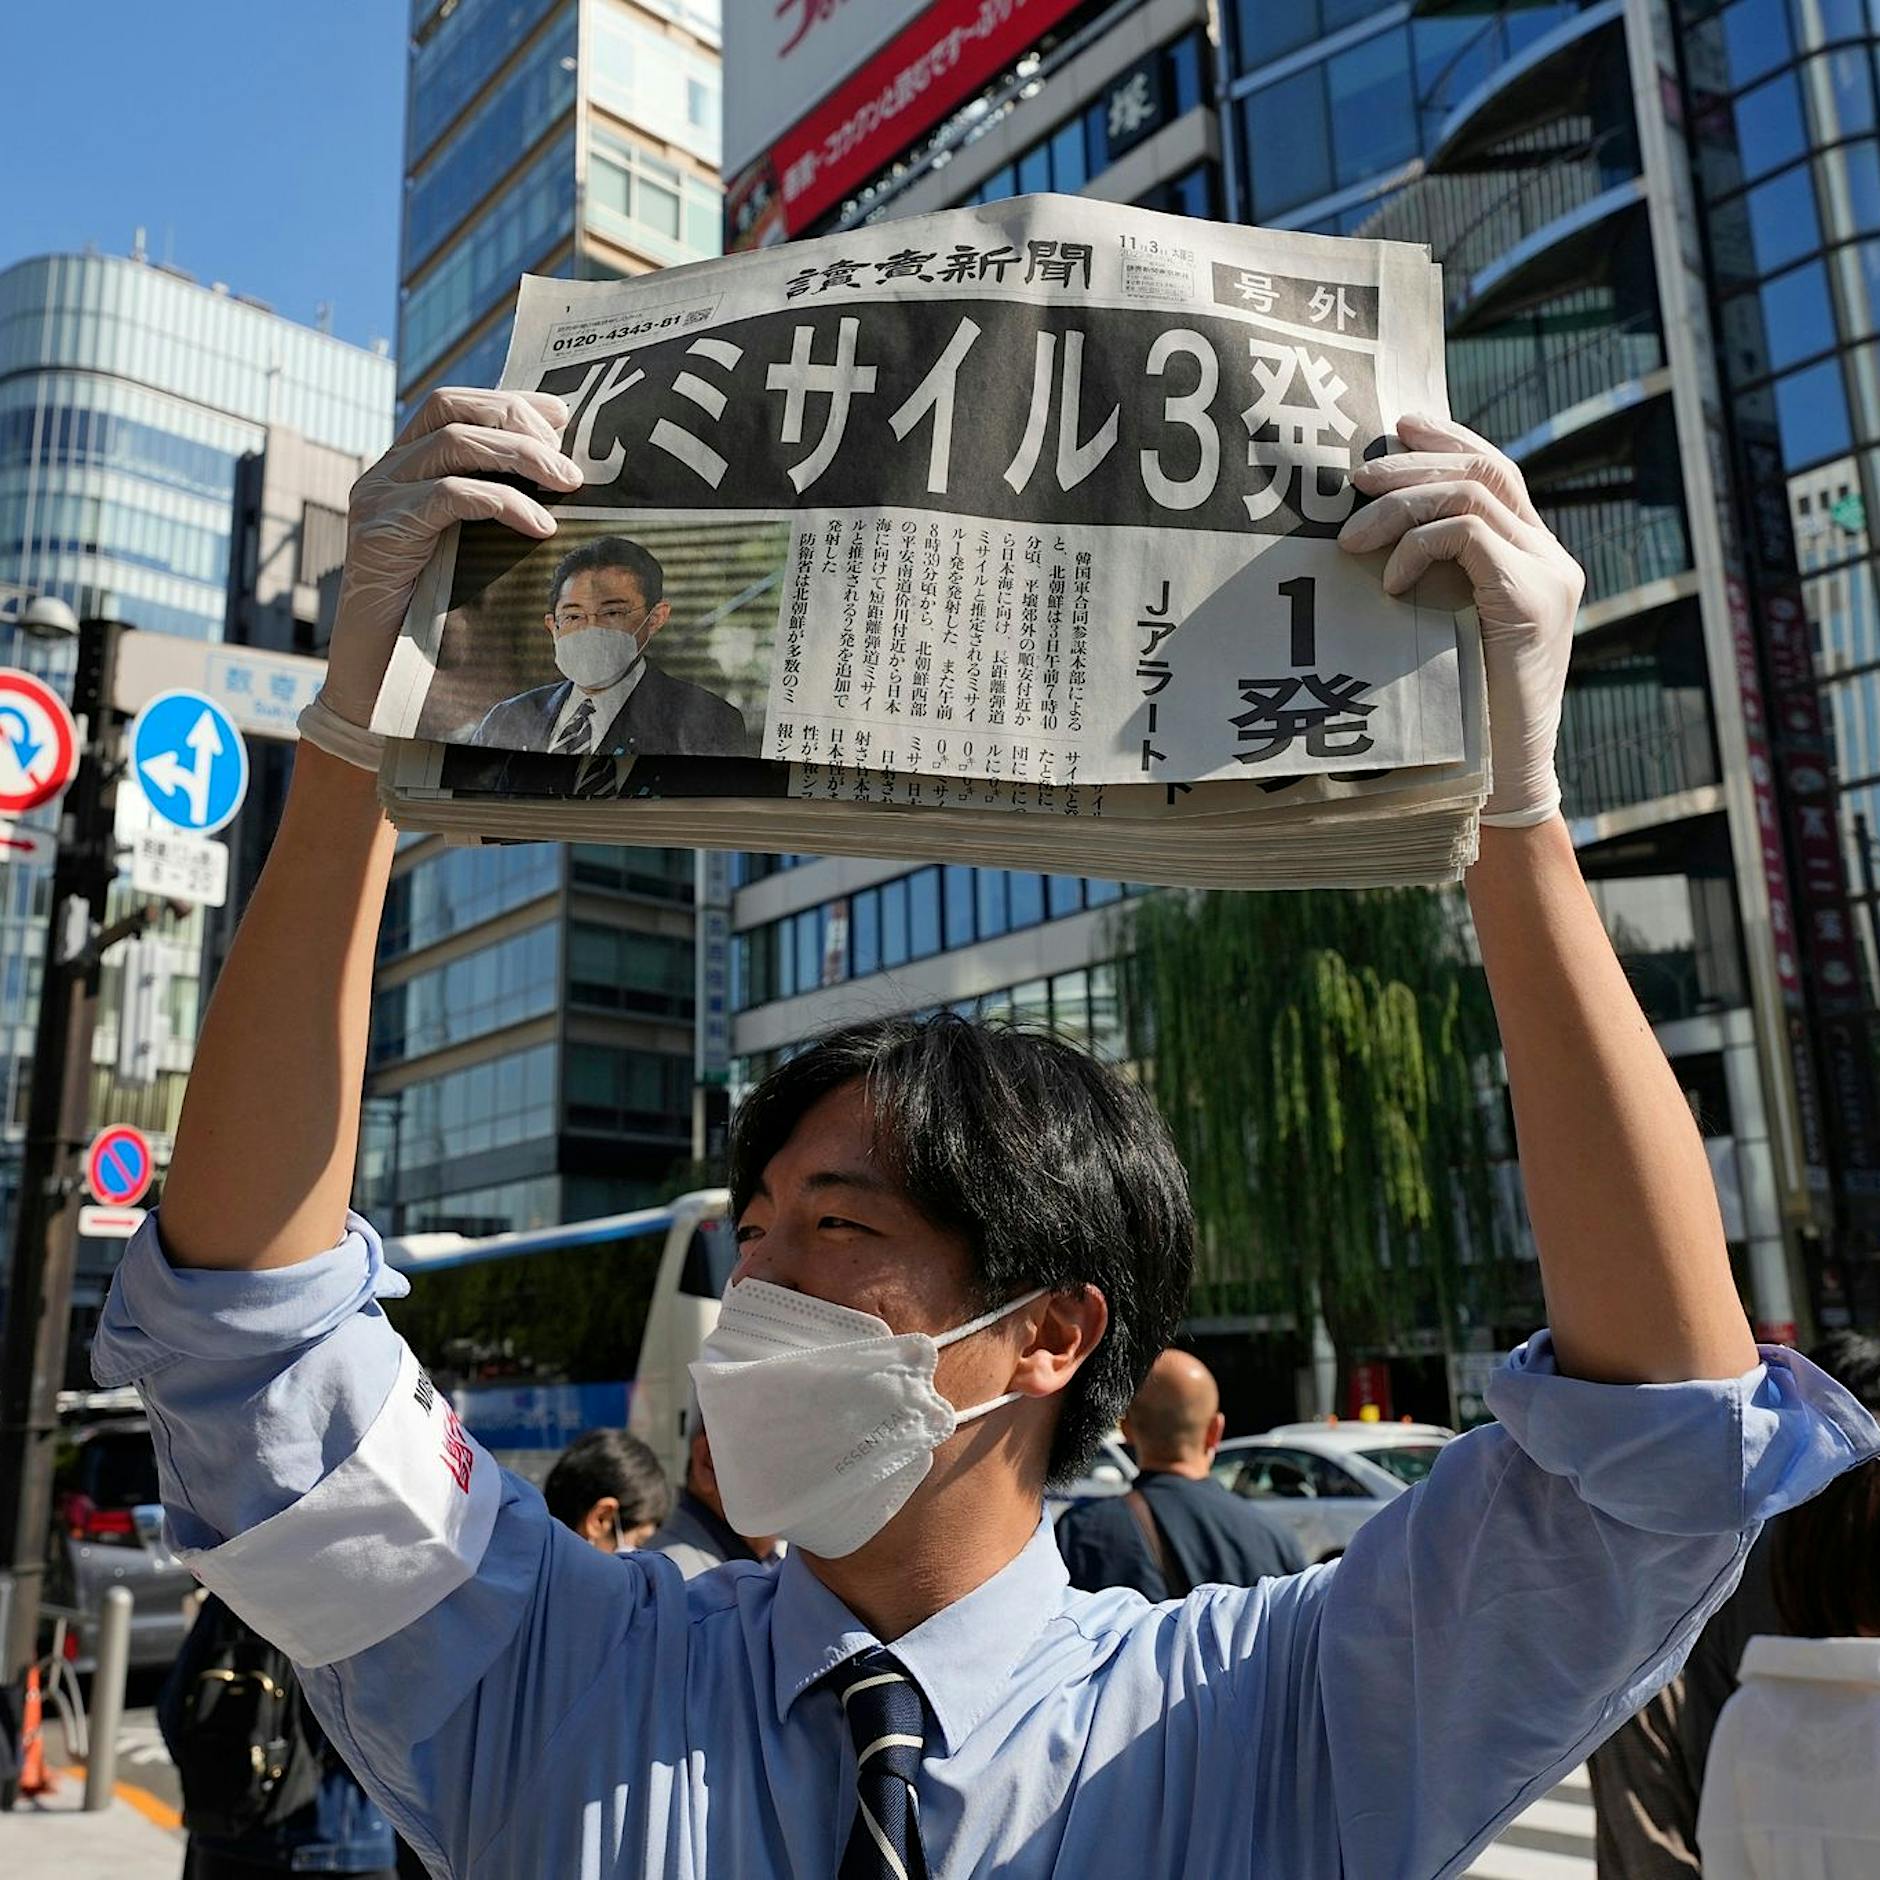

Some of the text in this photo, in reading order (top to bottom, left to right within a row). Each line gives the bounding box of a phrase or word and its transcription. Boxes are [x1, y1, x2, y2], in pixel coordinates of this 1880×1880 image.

[552, 315, 682, 351] 0120-4343-81
[1234, 270, 1357, 331] 号外
[557, 315, 1359, 524] 北ミサイル3発
[1136, 580, 1177, 771] Jアラート
[1228, 576, 1379, 765] 1発
